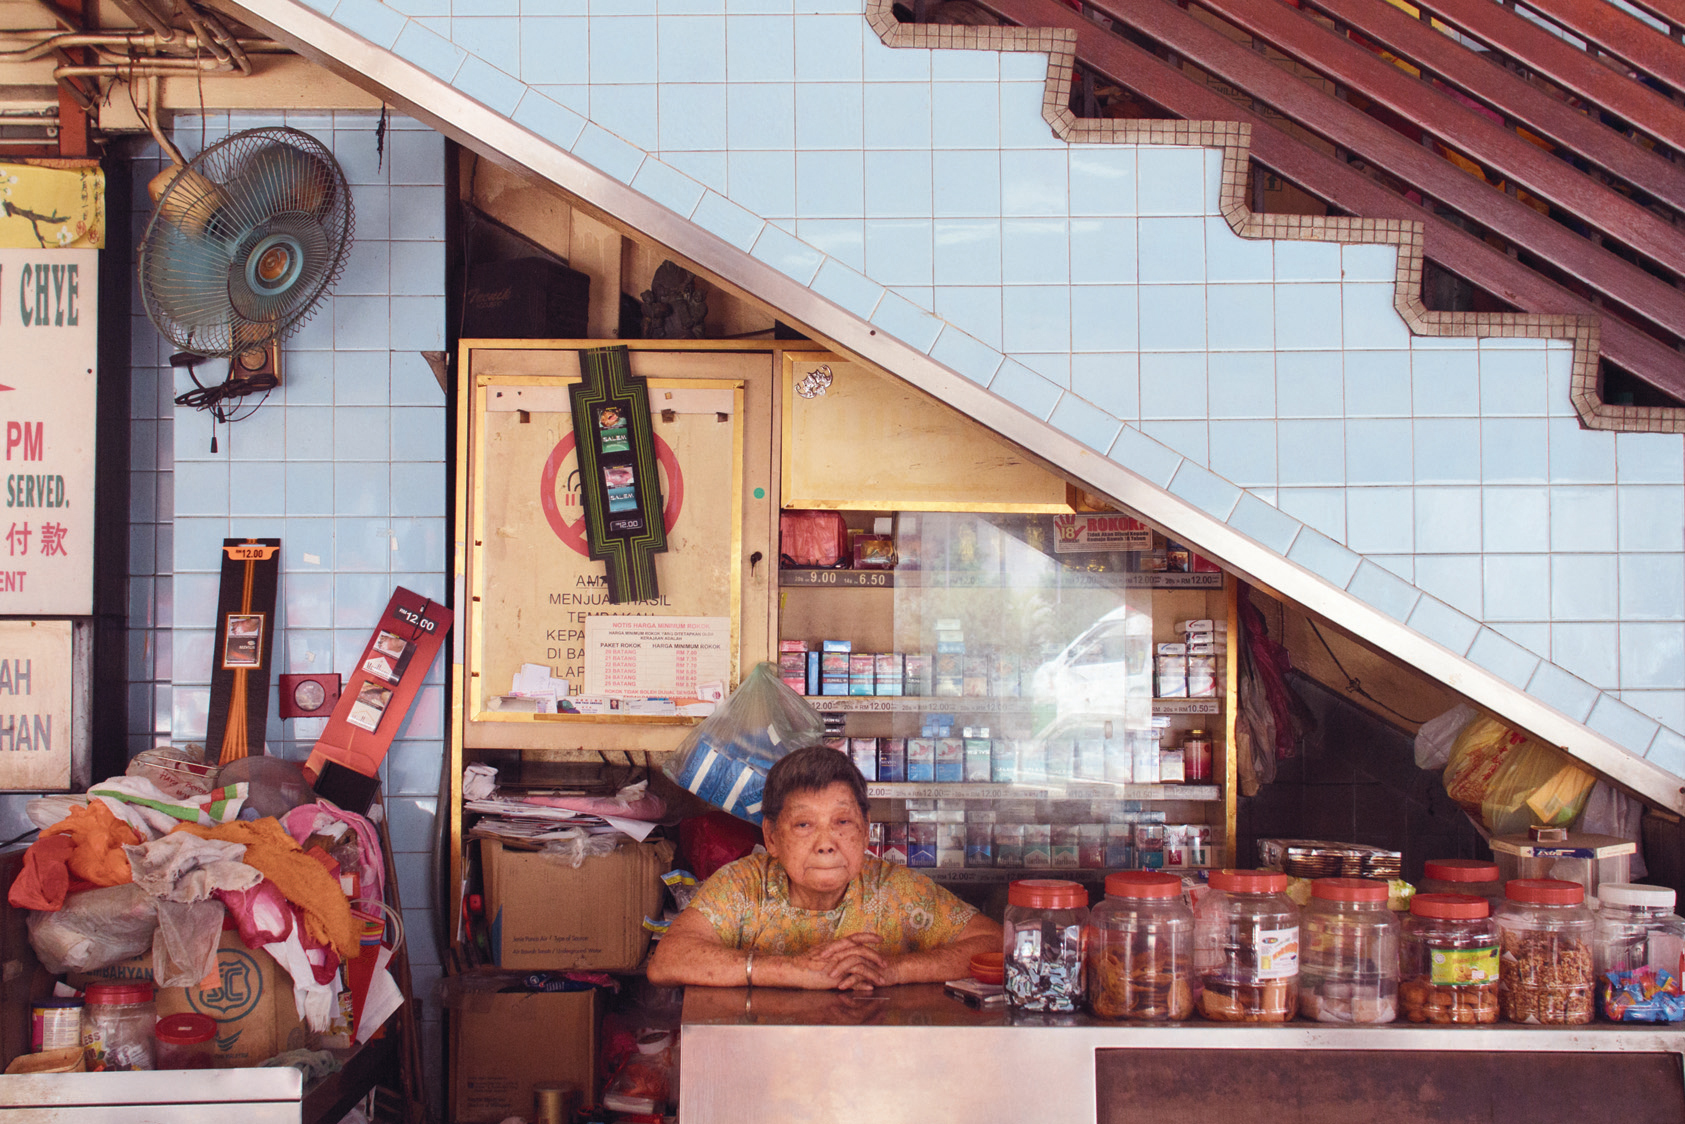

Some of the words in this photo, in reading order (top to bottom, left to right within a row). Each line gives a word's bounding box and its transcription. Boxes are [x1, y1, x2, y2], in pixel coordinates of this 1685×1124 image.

[20, 262, 79, 327] CHYE
[6, 421, 44, 461] PM
[602, 434, 627, 443] SALEM
[6, 474, 70, 509] SERVED.
[610, 492, 634, 501] SALEM
[1061, 526, 1075, 540] 18
[5, 521, 68, 557] 付款
[810, 571, 836, 584] 9.00
[859, 573, 885, 585] 6.50
[1191, 575, 1212, 584] 12.00
[612, 622, 632, 630] NOTIS
[633, 622, 656, 630] HARGA
[657, 622, 686, 630] MINIMUM
[547, 648, 561, 660] DI
[870, 702, 891, 710] 12.00
[929, 703, 949, 711] 12.00
[1188, 704, 1208, 713] 10.50
[713, 772, 735, 803] PREMIER
[868, 788, 885, 796] 2.00
[923, 789, 943, 797] 12.00
[948, 872, 969, 880] 12.00
